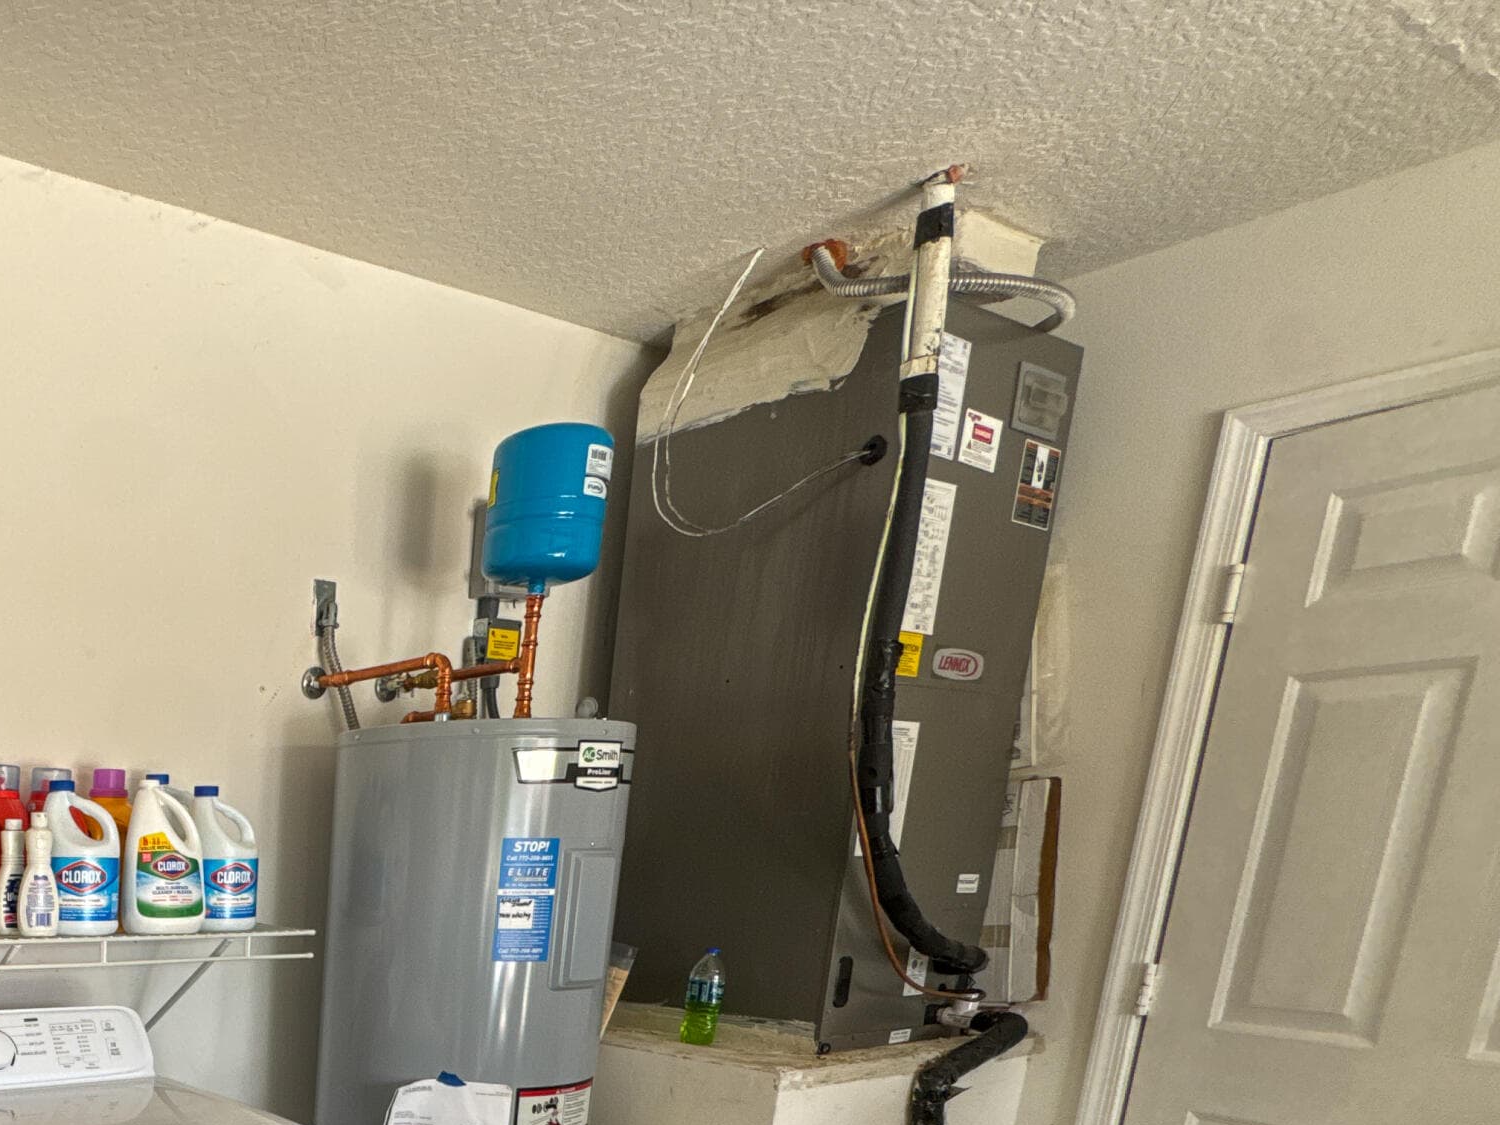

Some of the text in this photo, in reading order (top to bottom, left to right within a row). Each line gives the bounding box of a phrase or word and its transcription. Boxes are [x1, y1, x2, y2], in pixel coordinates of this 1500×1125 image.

[937, 655, 972, 673] LENNOX
[596, 749, 619, 761] Smith
[513, 841, 550, 852] STOP!
[157, 861, 186, 872] CLOROX
[507, 867, 549, 877] ELITE
[61, 870, 102, 884] CLOROX
[216, 871, 252, 884] CLOROX
